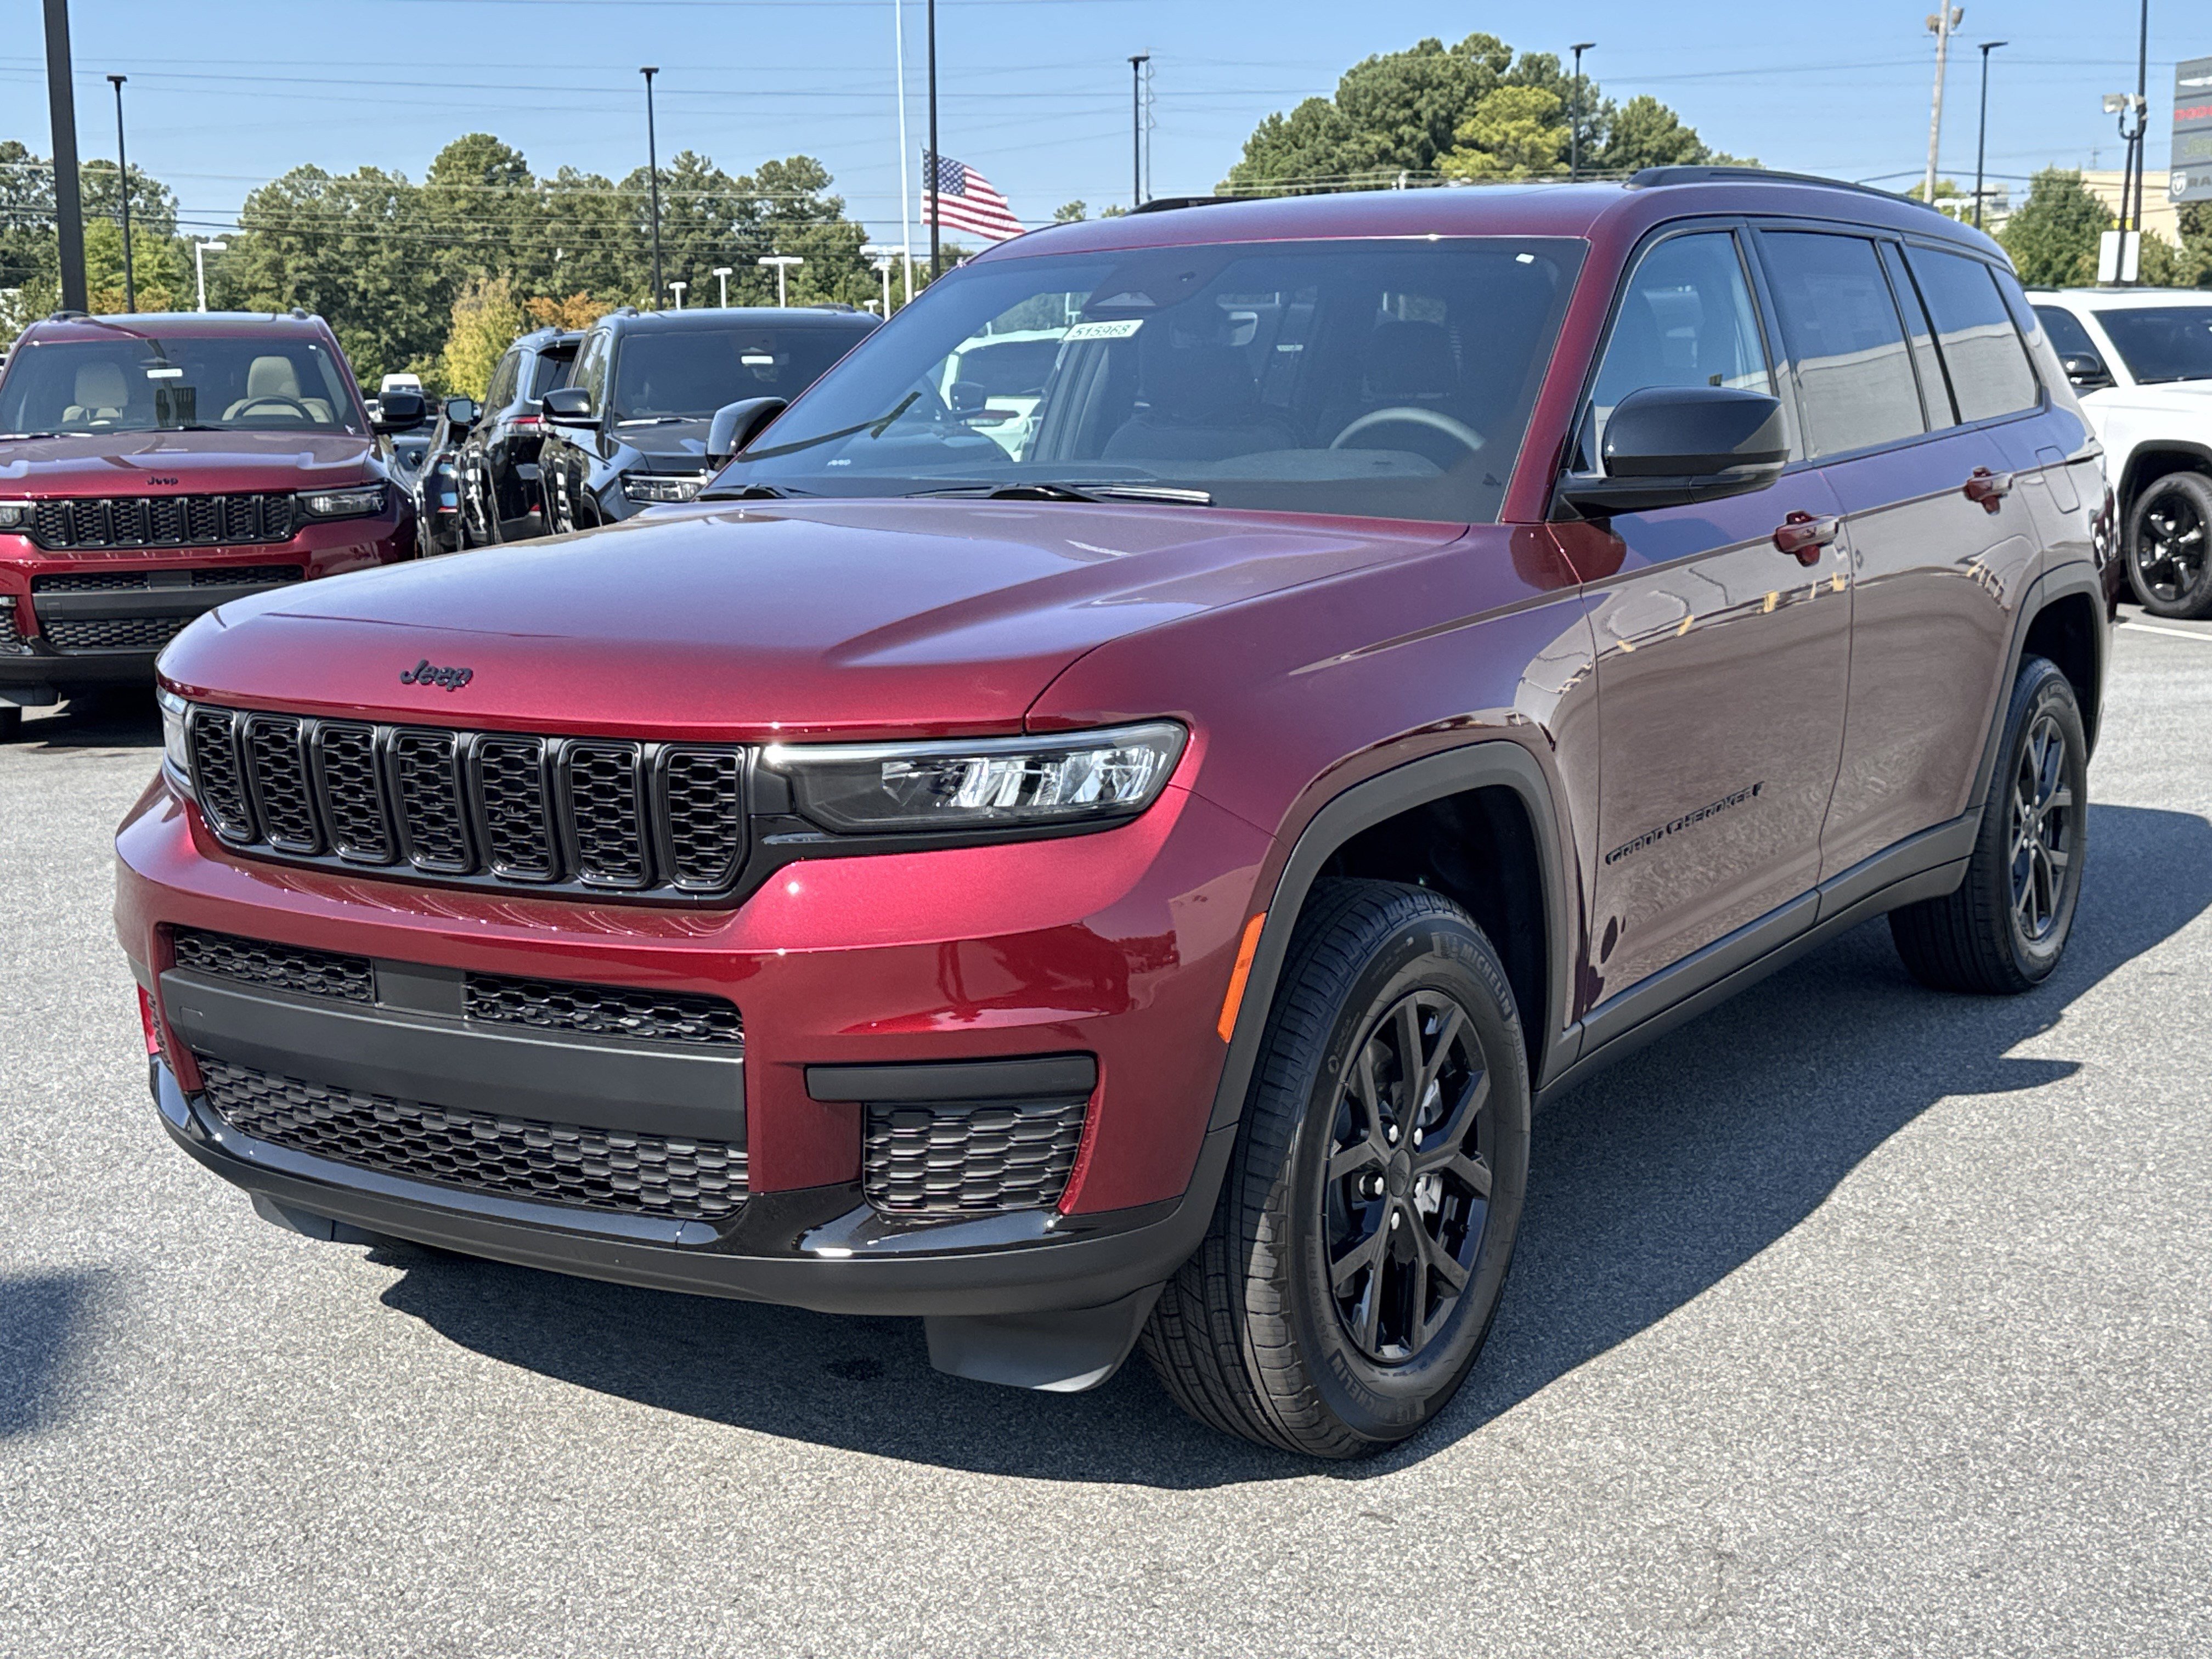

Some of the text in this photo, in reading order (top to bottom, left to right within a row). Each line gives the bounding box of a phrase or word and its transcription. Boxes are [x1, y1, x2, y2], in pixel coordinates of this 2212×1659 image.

[2175, 105, 2212, 121] DOD
[2188, 175, 2211, 188] RA
[1071, 324, 1131, 338] 515968
[147, 476, 178, 486] Jeep
[400, 659, 473, 692] Jeep
[1461, 943, 1512, 1015] MICHELIN
